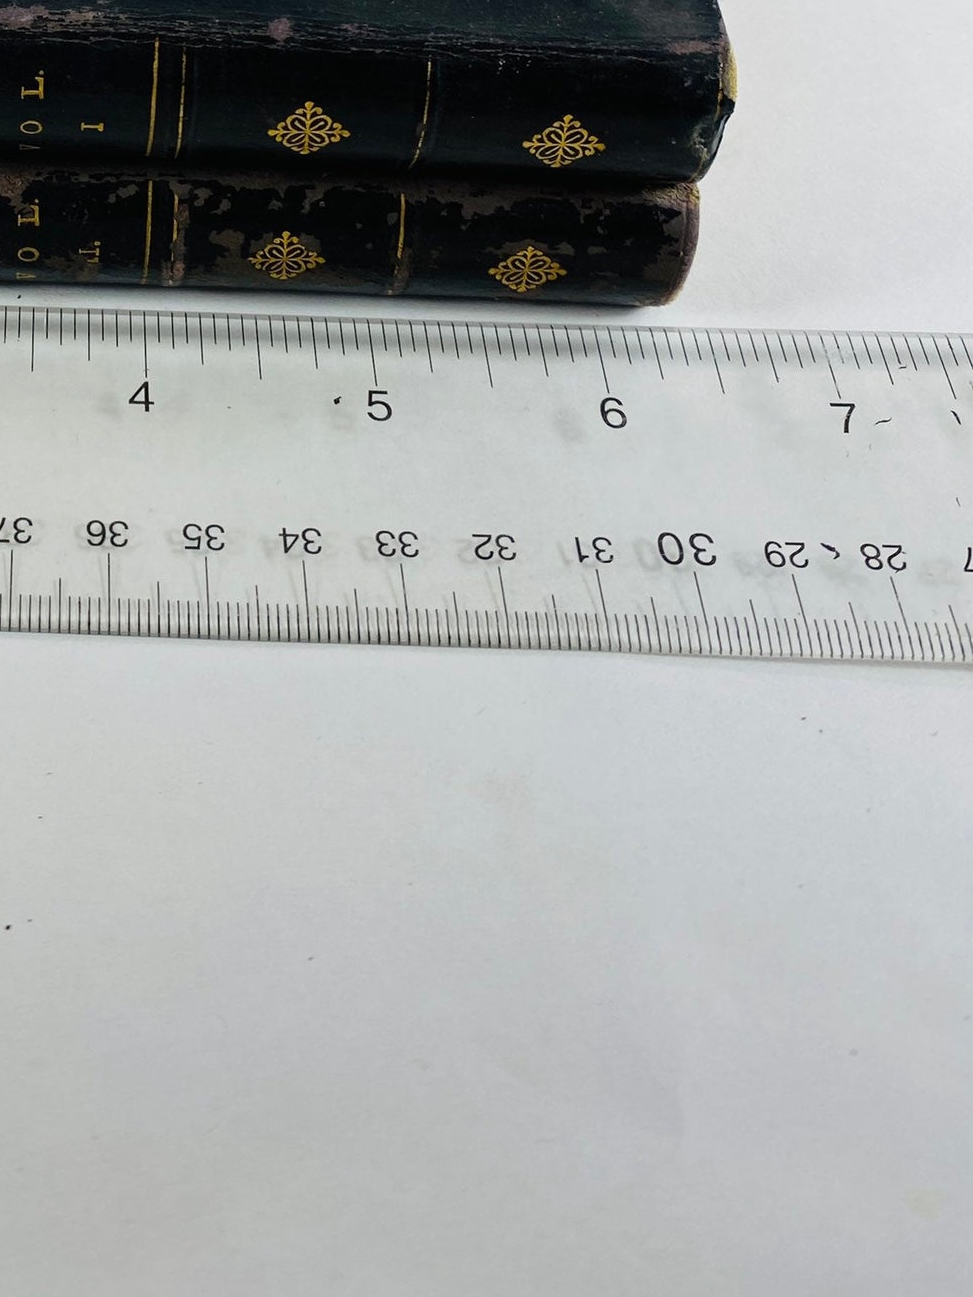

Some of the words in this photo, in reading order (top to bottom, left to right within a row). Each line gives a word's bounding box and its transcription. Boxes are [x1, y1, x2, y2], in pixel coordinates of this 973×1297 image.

[128, 380, 155, 413] 4
[366, 390, 393, 422] 5
[600, 397, 628, 429] 6
[830, 403, 857, 434] 7
[85, 519, 130, 548] 36
[182, 523, 226, 552] 35
[278, 527, 323, 555] 34
[375, 530, 420, 559] 33
[472, 533, 517, 562] 32
[574, 536, 614, 563] 31
[657, 531, 717, 567] 30
[764, 540, 810, 569] 29
[859, 543, 907, 571] 28
